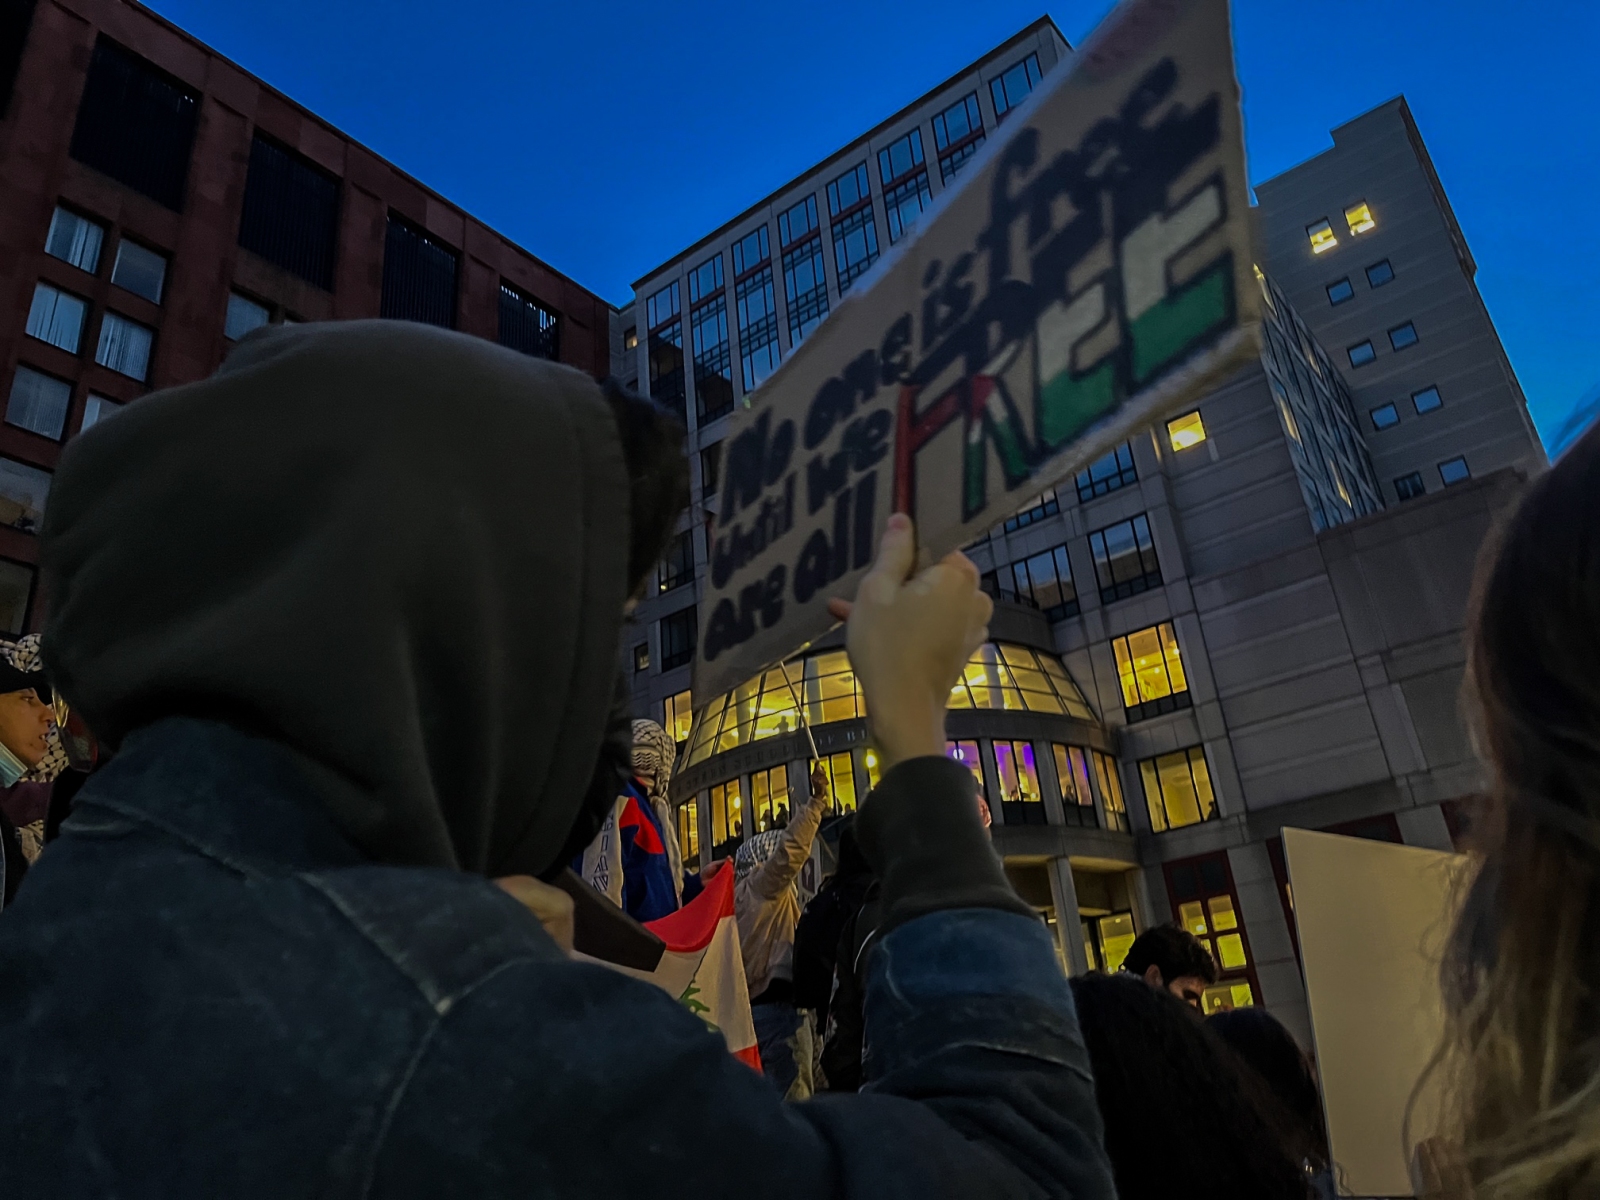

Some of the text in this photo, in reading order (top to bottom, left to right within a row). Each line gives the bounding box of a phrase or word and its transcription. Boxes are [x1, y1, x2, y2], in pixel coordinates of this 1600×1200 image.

[720, 405, 796, 529] No
[804, 313, 912, 450] one
[921, 260, 976, 352] is
[793, 470, 878, 604] all
[893, 120, 1237, 525] FREE
[806, 409, 893, 517] we
